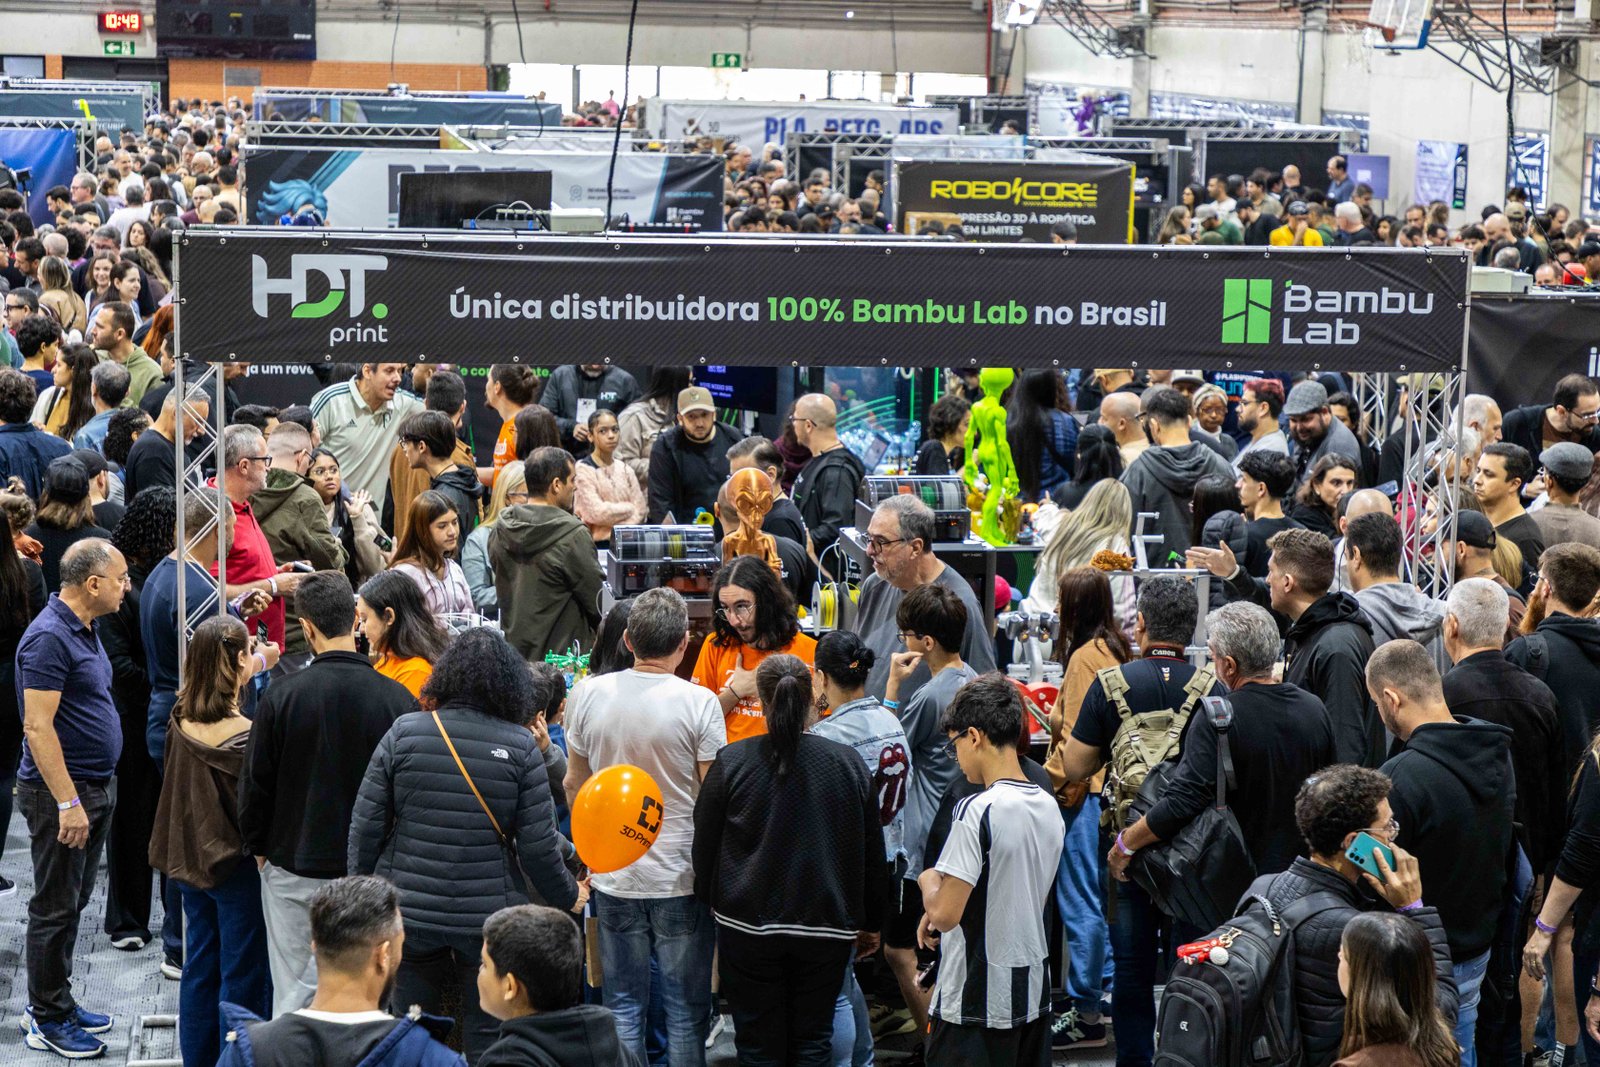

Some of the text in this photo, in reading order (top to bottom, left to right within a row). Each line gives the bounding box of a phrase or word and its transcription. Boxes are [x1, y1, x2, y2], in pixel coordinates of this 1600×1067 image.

[105, 14, 138, 28] 10:49
[1012, 214, 1028, 224] 3D
[1029, 212, 1039, 224] À
[961, 226, 1024, 236] EM LIMITES
[1284, 279, 1434, 314] Bambu
[450, 286, 1166, 326] Única distribuidora 100% Bambu Lab no Brasil
[329, 322, 388, 347] print
[1282, 317, 1360, 345] Lab
[245, 364, 315, 378] ja um reve
[1151, 648, 1176, 657] Canon
